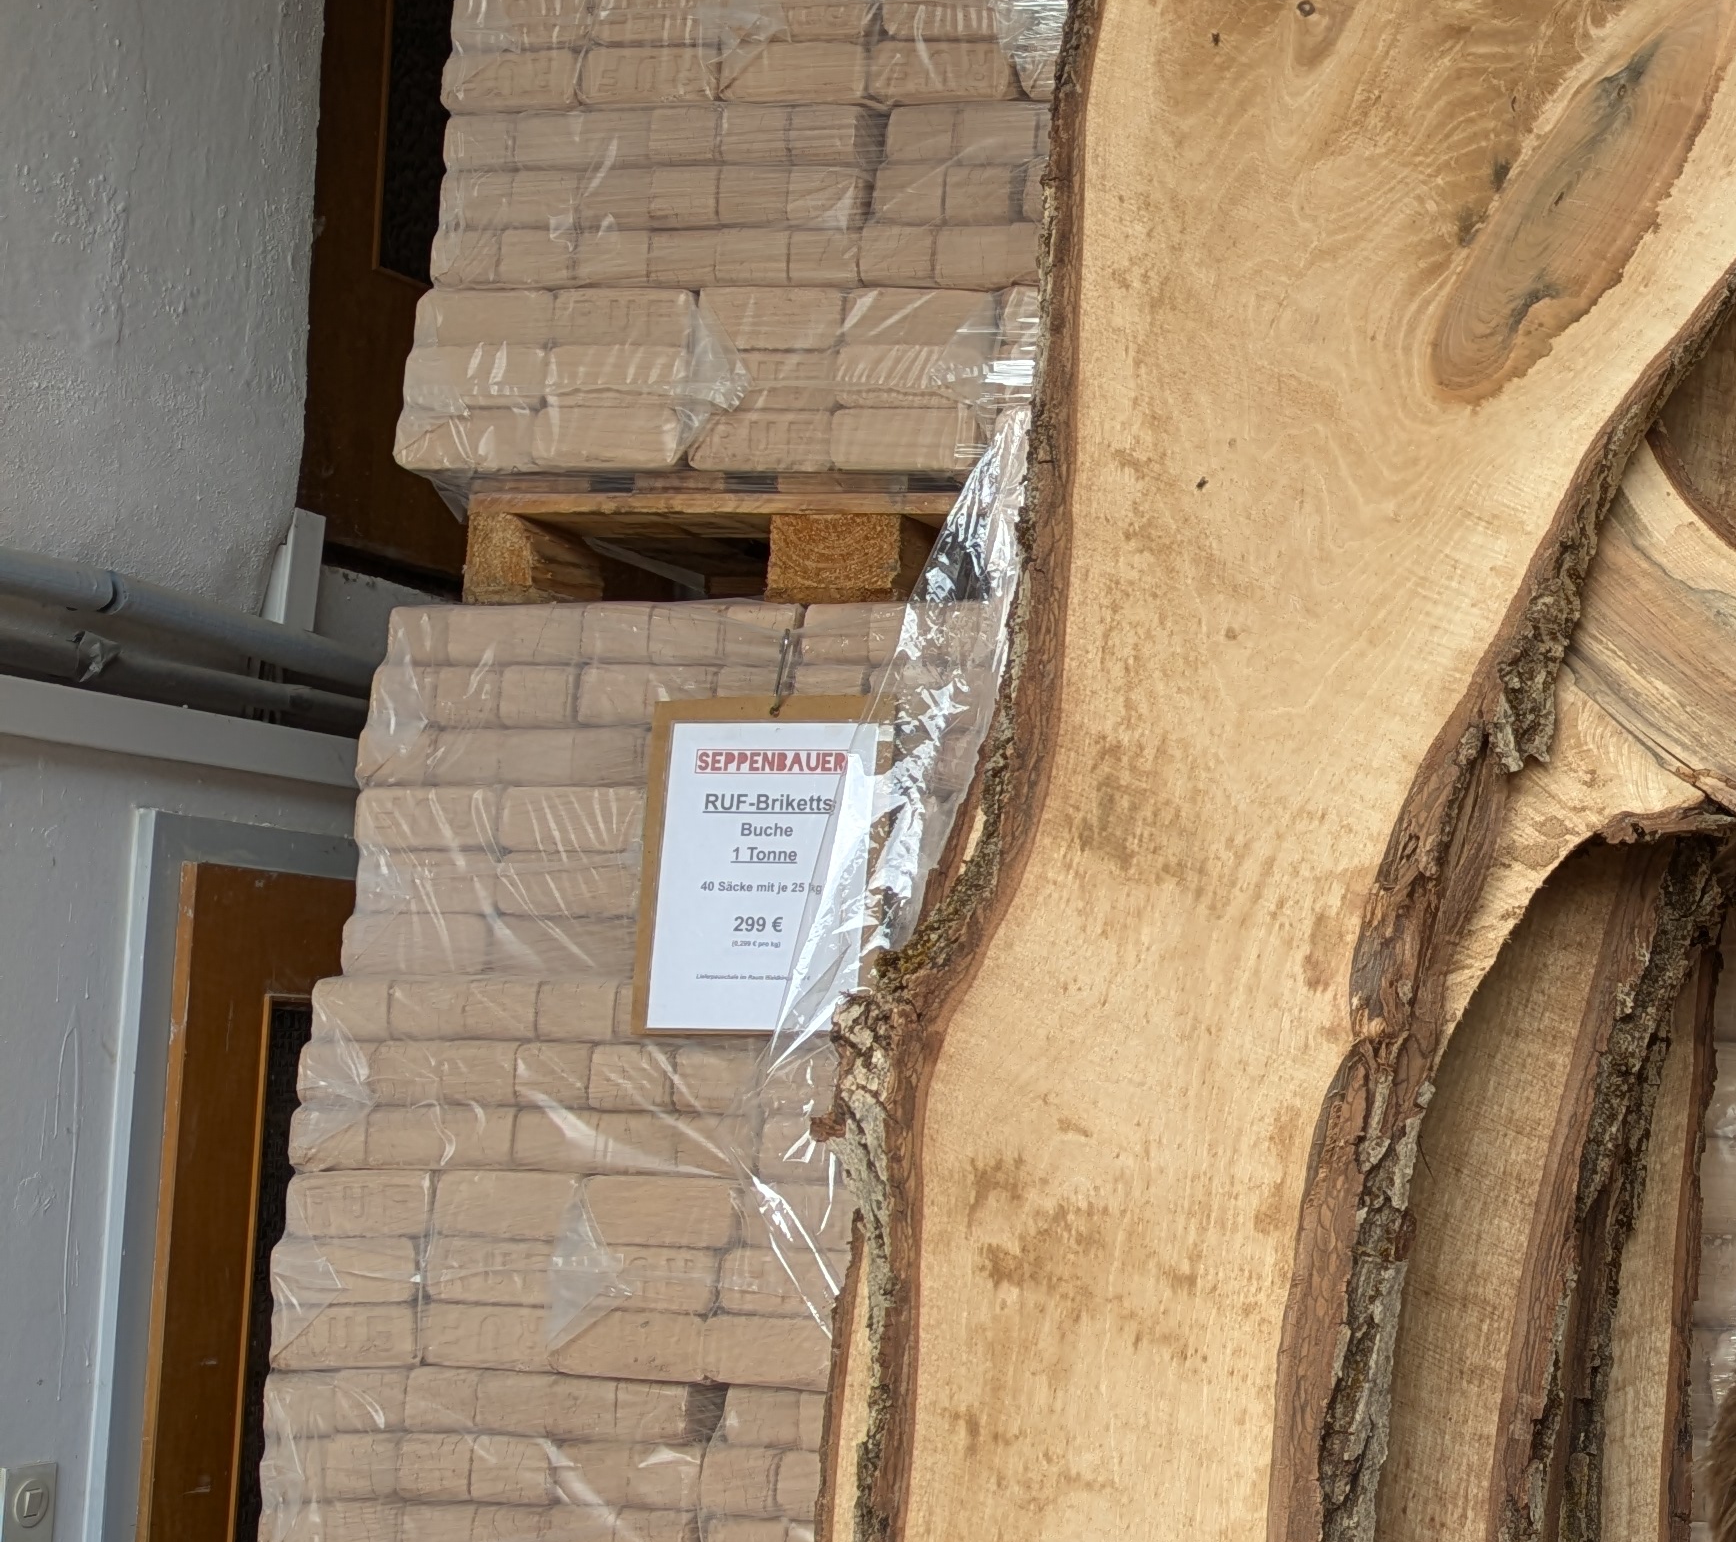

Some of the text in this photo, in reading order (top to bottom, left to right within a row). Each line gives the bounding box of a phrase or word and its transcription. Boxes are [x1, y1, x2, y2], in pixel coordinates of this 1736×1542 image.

[697, 751, 846, 773] SEPPENBAUER
[704, 793, 836, 812] RUF-Briketts
[740, 822, 794, 837] Buche
[732, 846, 798, 862] 1 Tonne
[700, 880, 823, 895] 40 Säcke mit je 25 kg
[733, 916, 784, 933] 299 €
